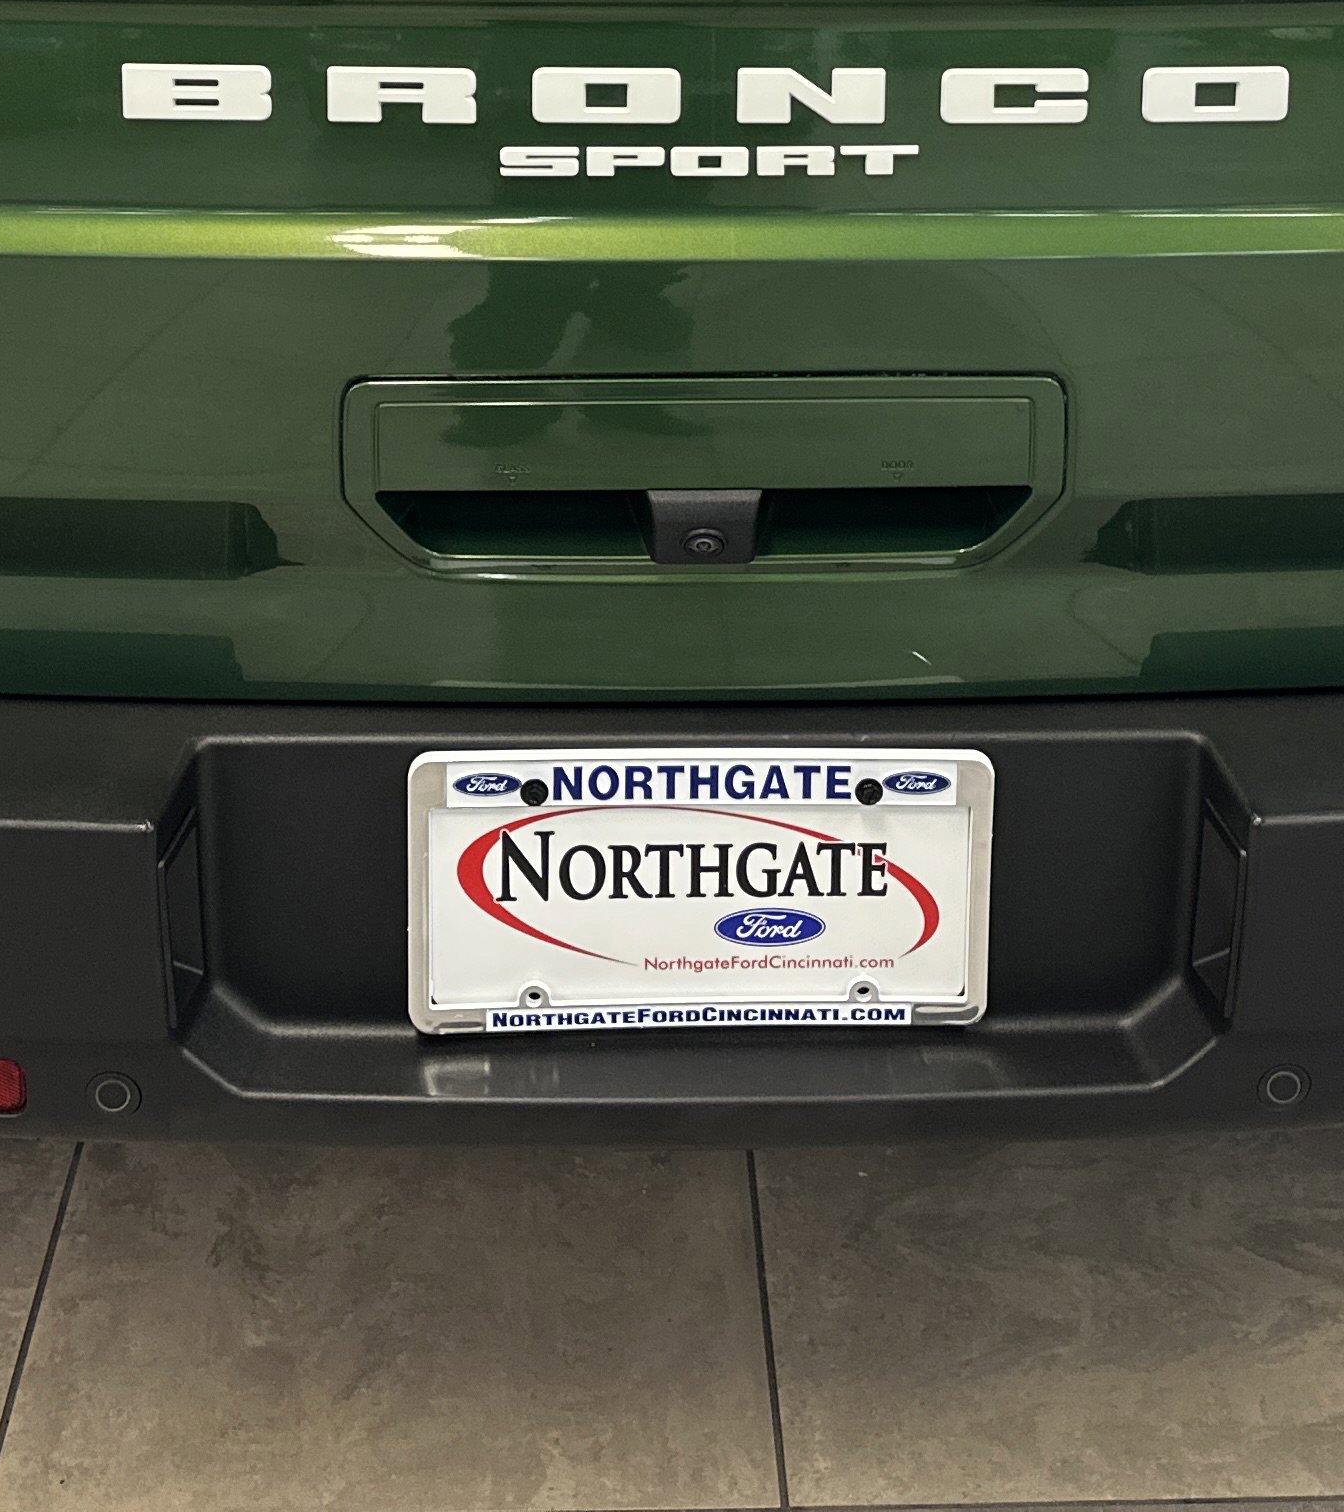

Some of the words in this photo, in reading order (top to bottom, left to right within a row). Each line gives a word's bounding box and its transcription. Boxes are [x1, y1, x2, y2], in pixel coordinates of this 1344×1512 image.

[120, 62, 1291, 125] BRONCO
[498, 143, 920, 178] SPORT
[466, 776, 507, 793] Ford
[552, 764, 852, 801] NORTHGATE
[895, 774, 937, 791] Ford
[495, 830, 889, 902] NORTHGATE
[735, 913, 803, 939] Ford
[643, 954, 895, 973] NorthgateFordCincinnati.com
[491, 1006, 906, 1029] NORTHGATEFORDCINCINNATI.COM
